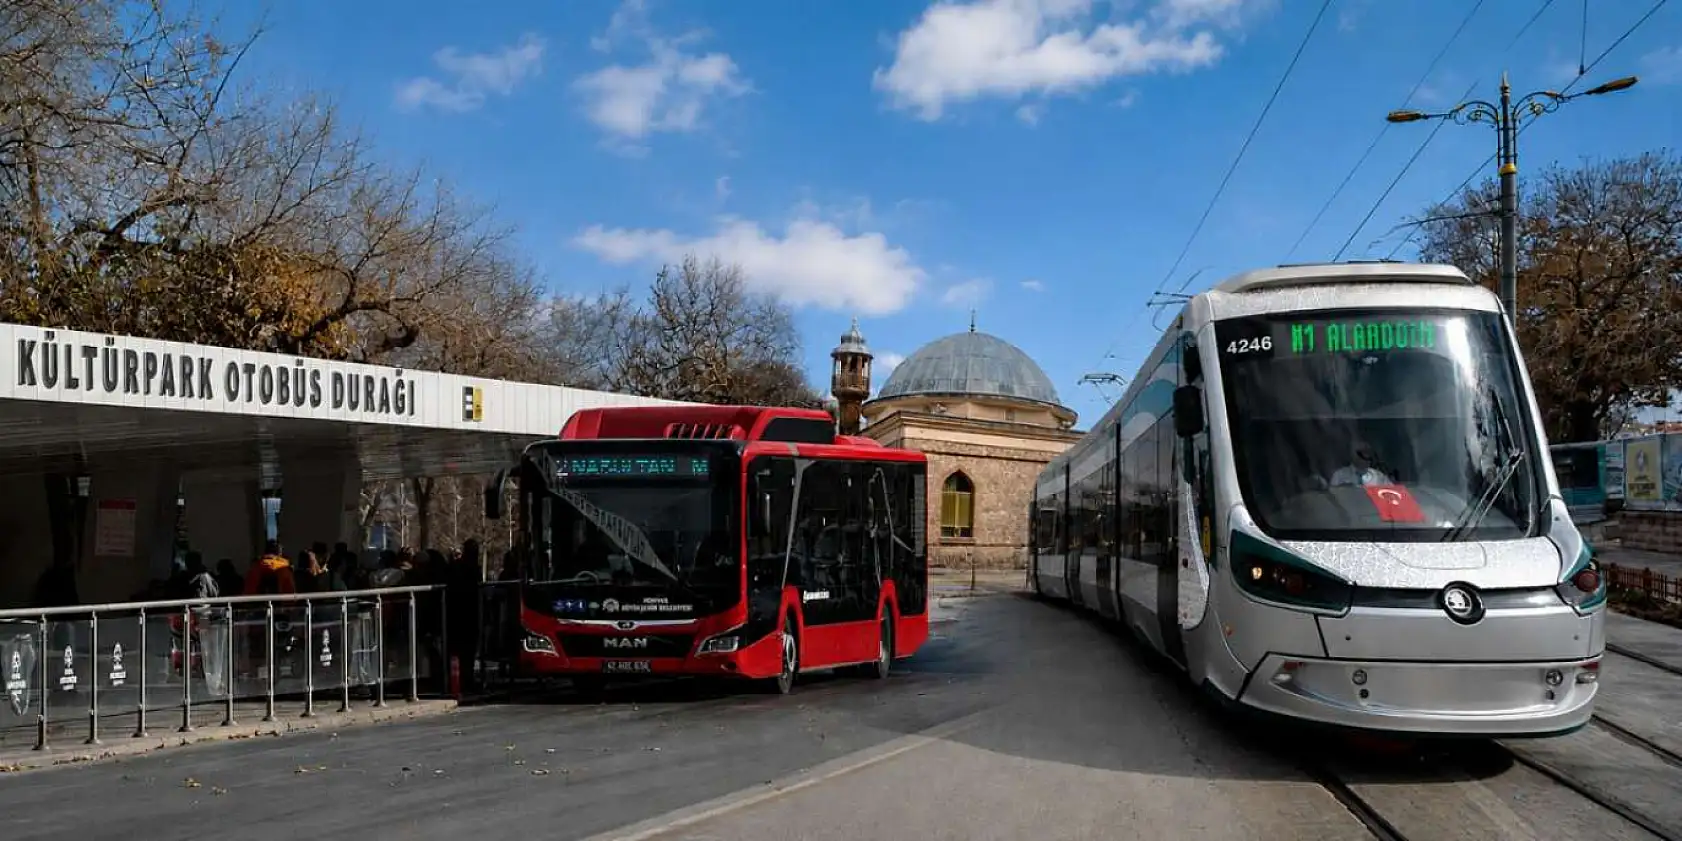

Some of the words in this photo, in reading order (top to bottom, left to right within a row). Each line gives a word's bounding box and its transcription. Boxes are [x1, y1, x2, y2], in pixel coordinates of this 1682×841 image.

[1227, 336, 1272, 354] 4246
[17, 331, 214, 399] KÜLTÜRPARK
[224, 358, 322, 408] OTOBÜS
[331, 368, 415, 416] DURAĞI
[603, 637, 647, 648] MAN
